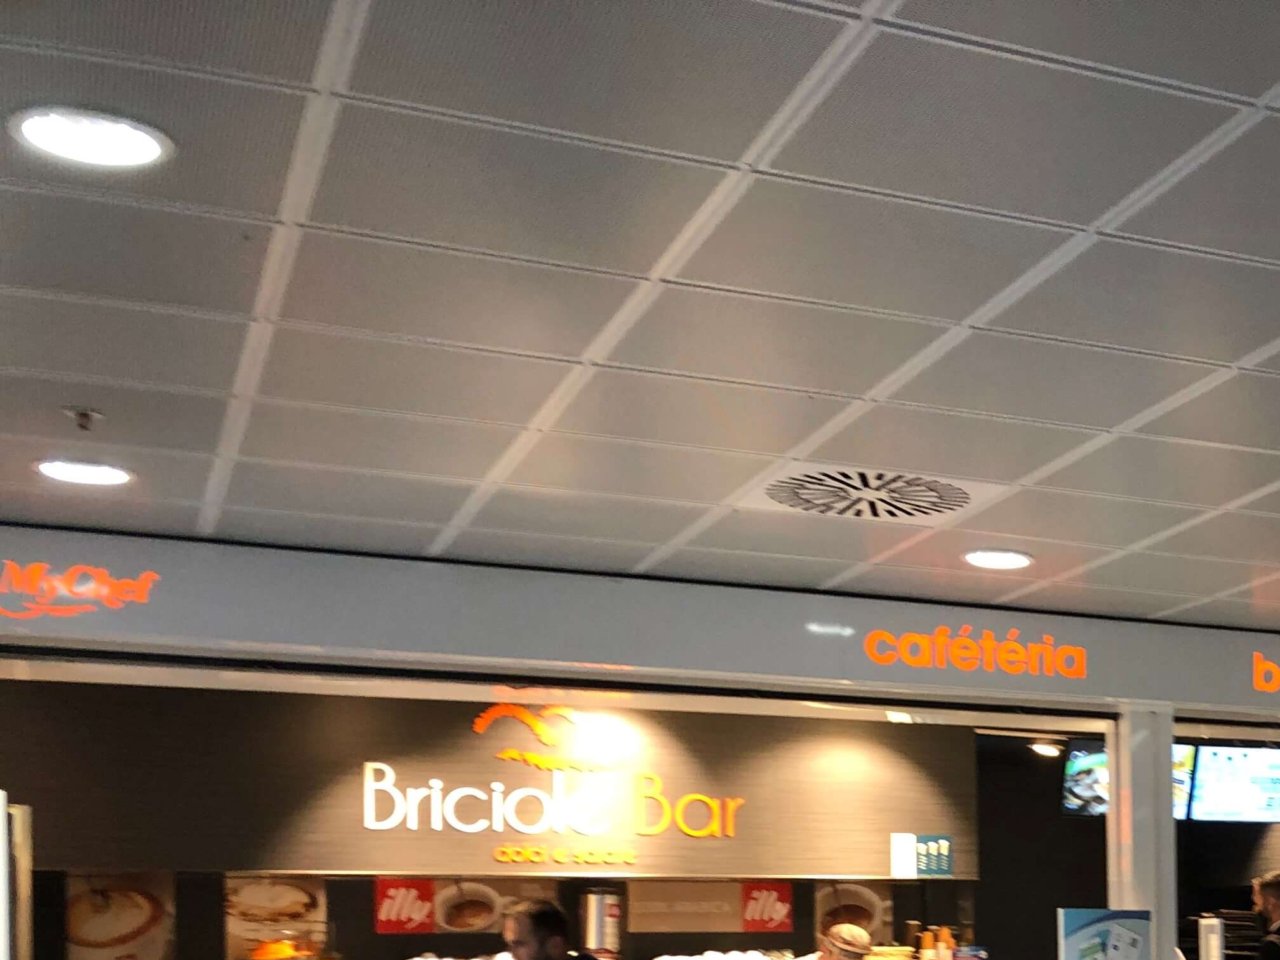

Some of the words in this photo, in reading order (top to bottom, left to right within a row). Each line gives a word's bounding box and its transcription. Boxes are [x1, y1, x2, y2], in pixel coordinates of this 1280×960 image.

[863, 624, 1088, 679] cafétéria
[362, 761, 612, 837] Briciol
[634, 771, 746, 838] Bar
[378, 886, 432, 930] illy
[744, 889, 791, 928] illy
